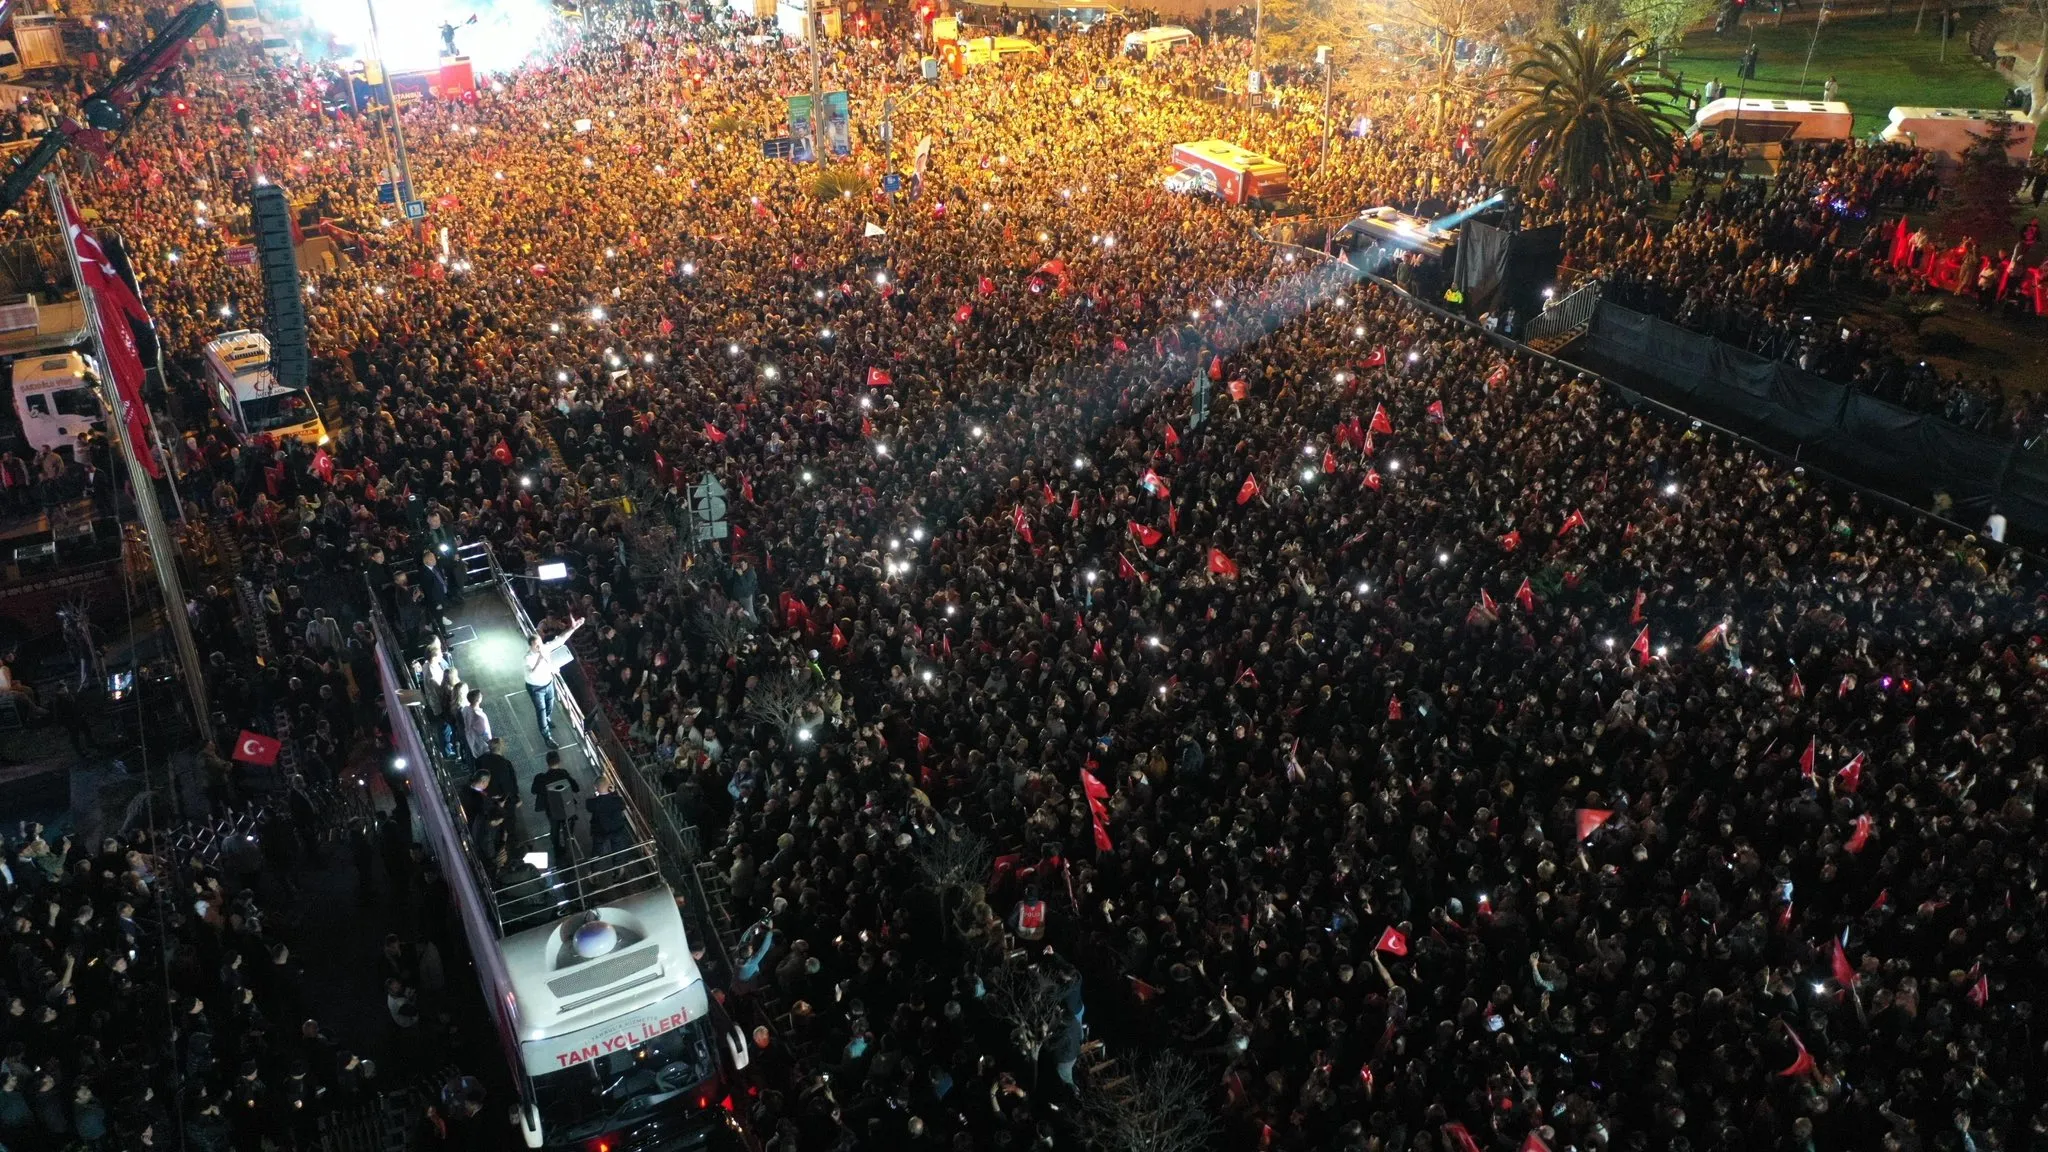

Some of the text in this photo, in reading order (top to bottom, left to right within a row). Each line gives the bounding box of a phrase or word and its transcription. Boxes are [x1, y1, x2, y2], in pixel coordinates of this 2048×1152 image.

[557, 1007, 688, 1067] TAM YOL İLERİ
